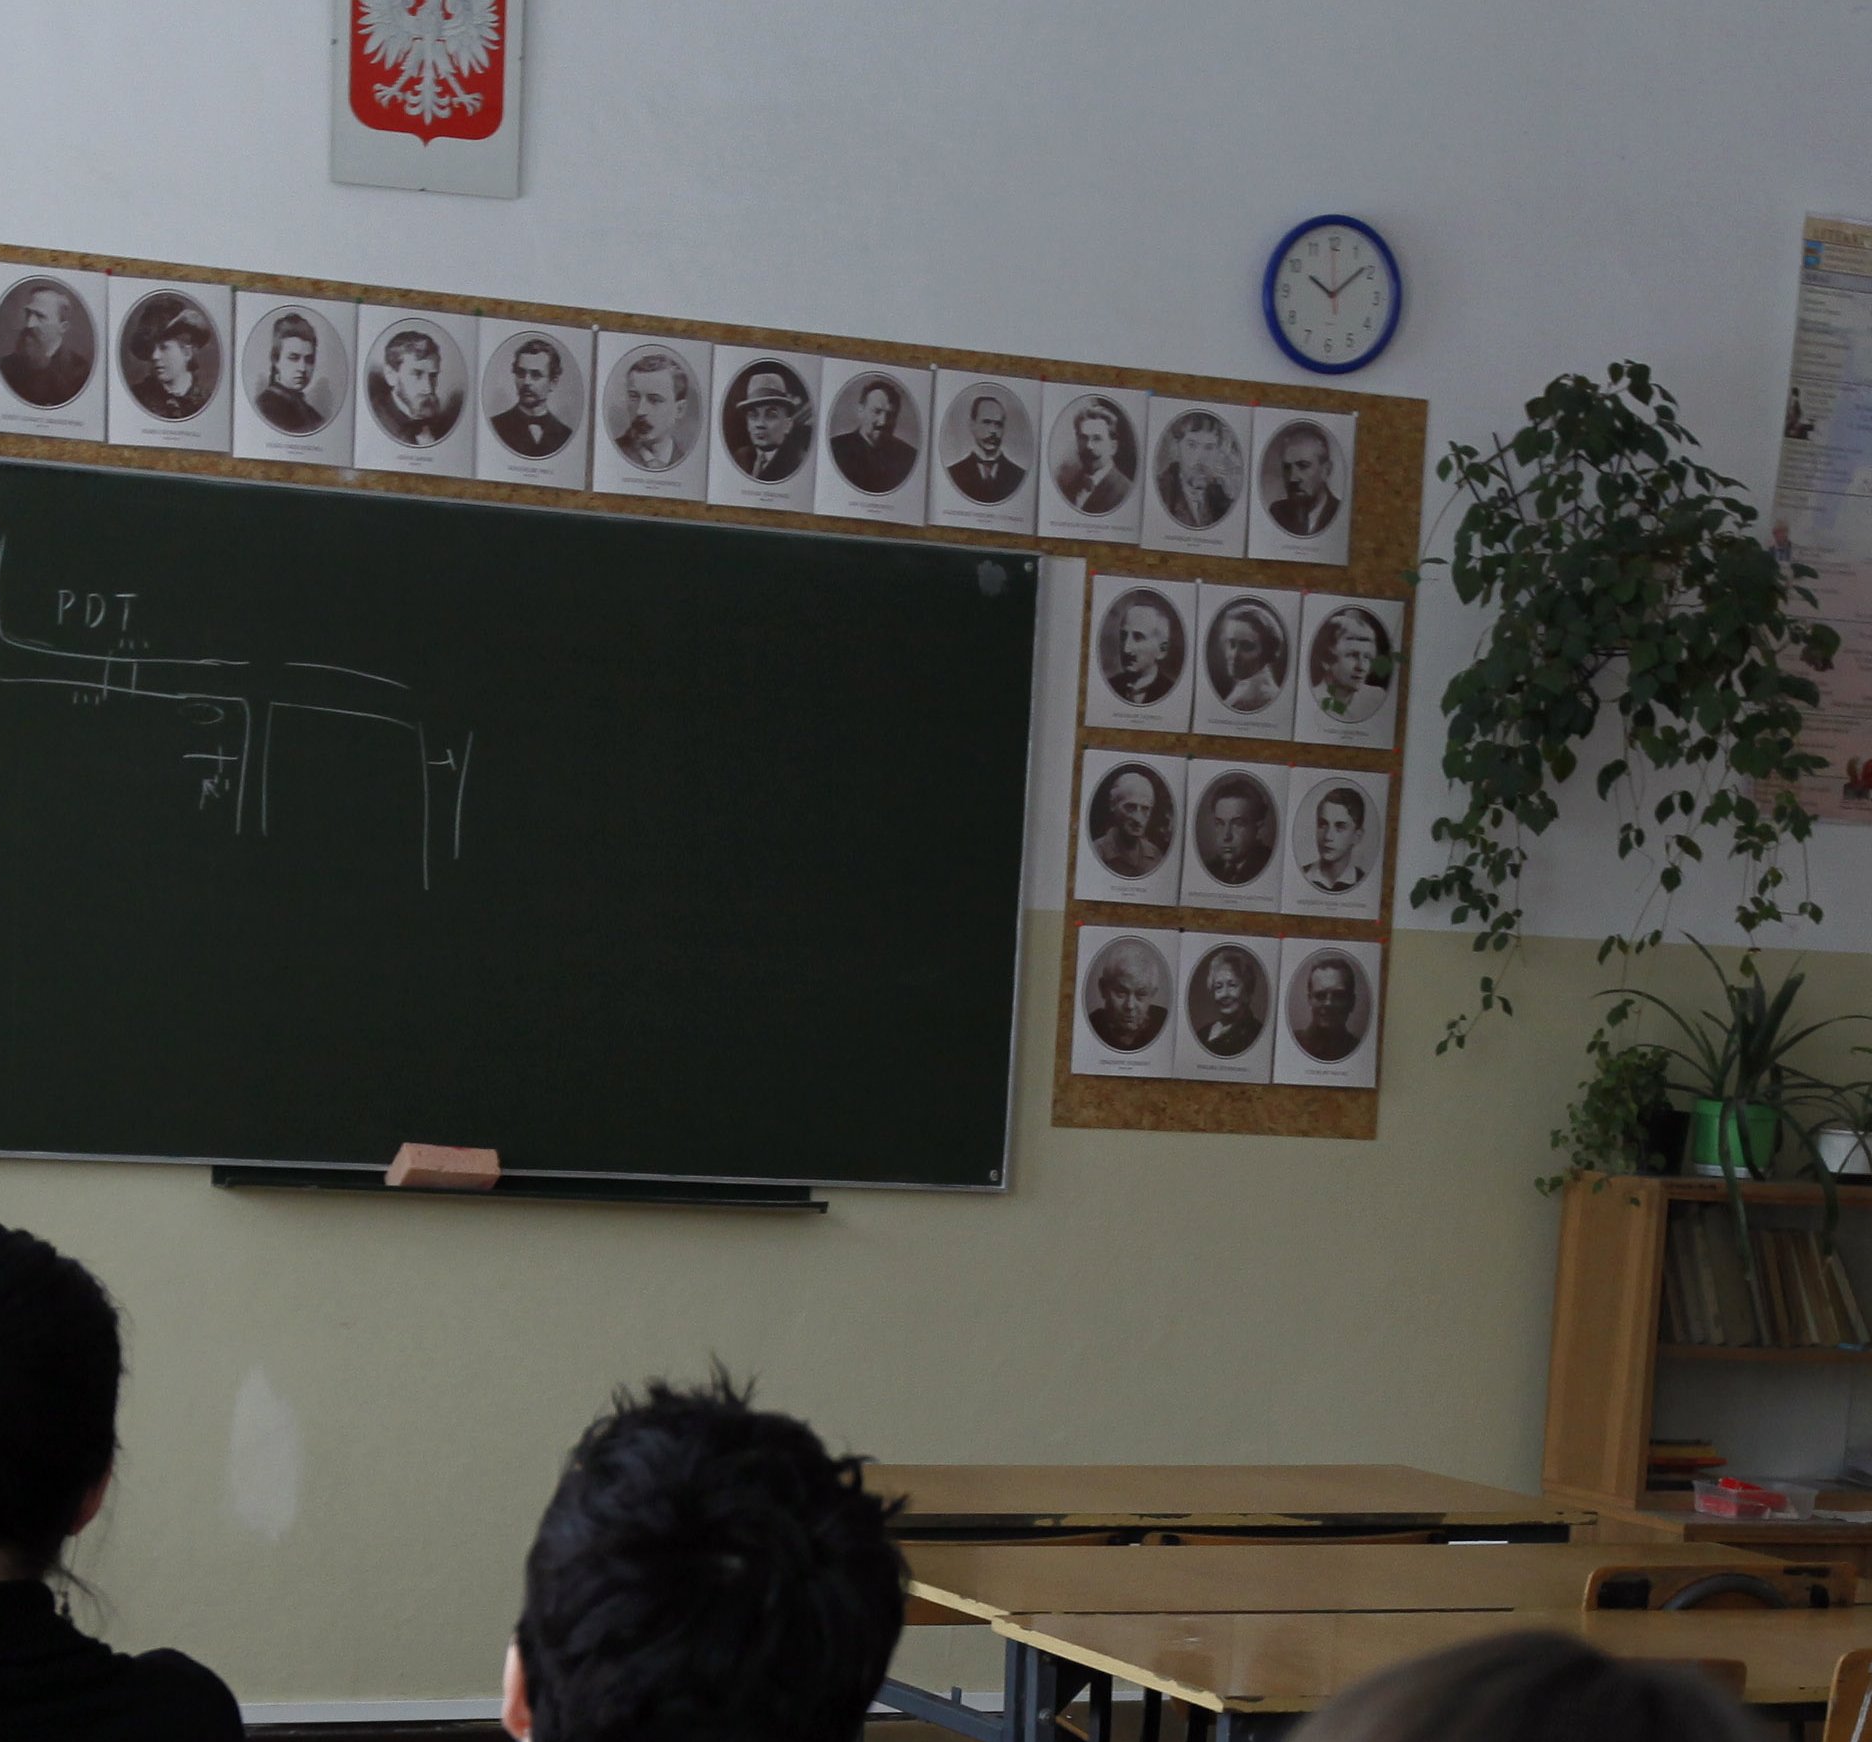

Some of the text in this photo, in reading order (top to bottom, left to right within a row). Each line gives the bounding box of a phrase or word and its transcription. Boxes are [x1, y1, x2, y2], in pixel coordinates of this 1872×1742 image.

[1308, 242, 1319, 256] 11
[1328, 236, 1342, 252] 12
[1290, 258, 1302, 273] 10
[1366, 265, 1376, 280] 2
[1282, 283, 1290, 299] 9
[1373, 291, 1381, 306] 3
[1288, 310, 1296, 325] 8
[1363, 316, 1373, 330] 4
[1304, 329, 1313, 344] 7
[1346, 332, 1355, 348] 5
[1324, 338, 1333, 353] 6
